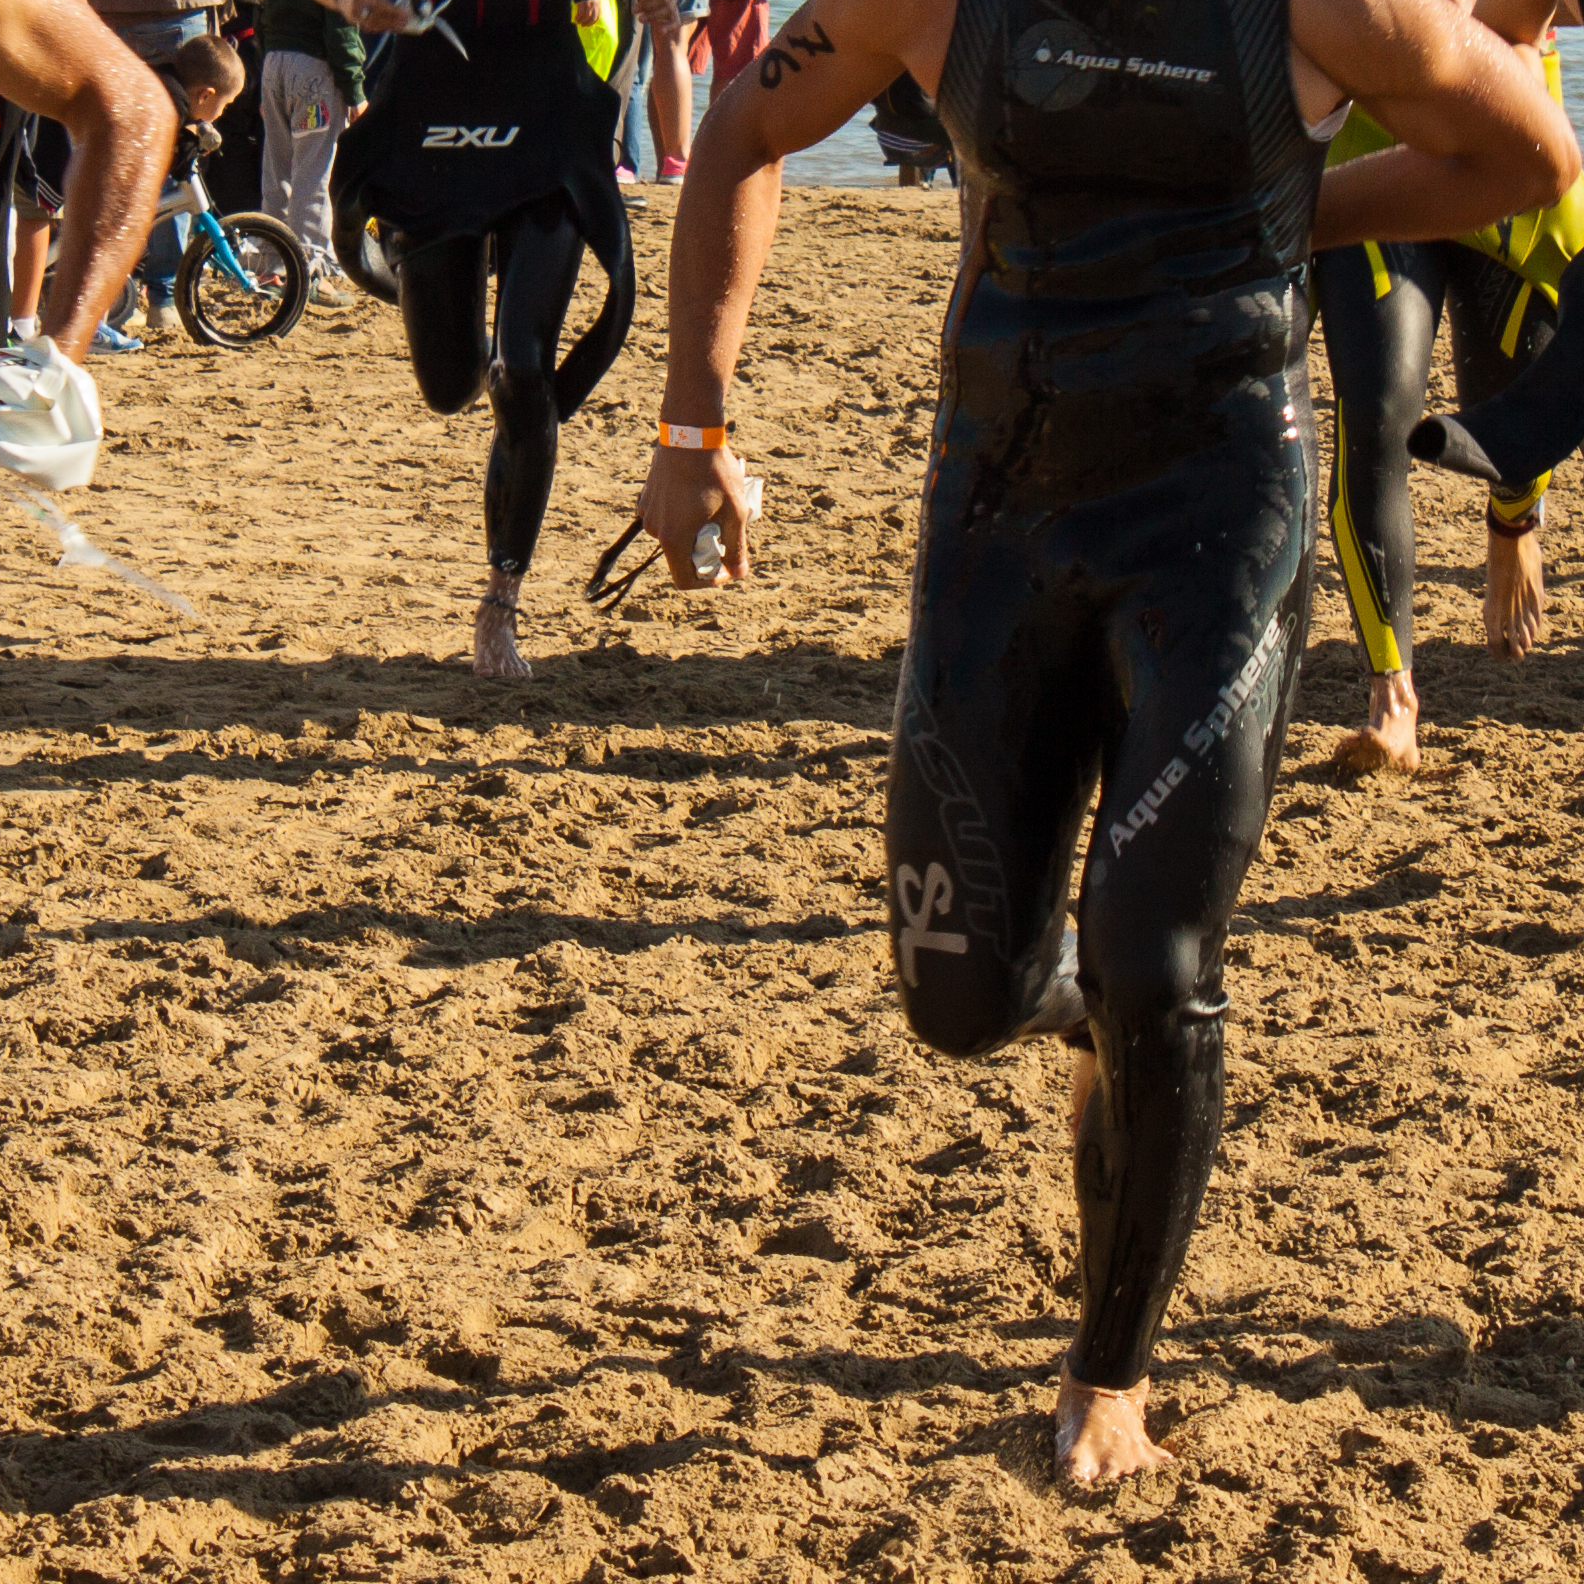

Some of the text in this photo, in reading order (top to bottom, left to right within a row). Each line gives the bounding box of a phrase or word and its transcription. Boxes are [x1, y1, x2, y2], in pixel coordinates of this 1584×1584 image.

[1056, 49, 1213, 83] Aqua Sphere
[421, 126, 521, 148] 2XU
[1109, 755, 1191, 858] Aqua
[1182, 613, 1282, 757] Sphere
